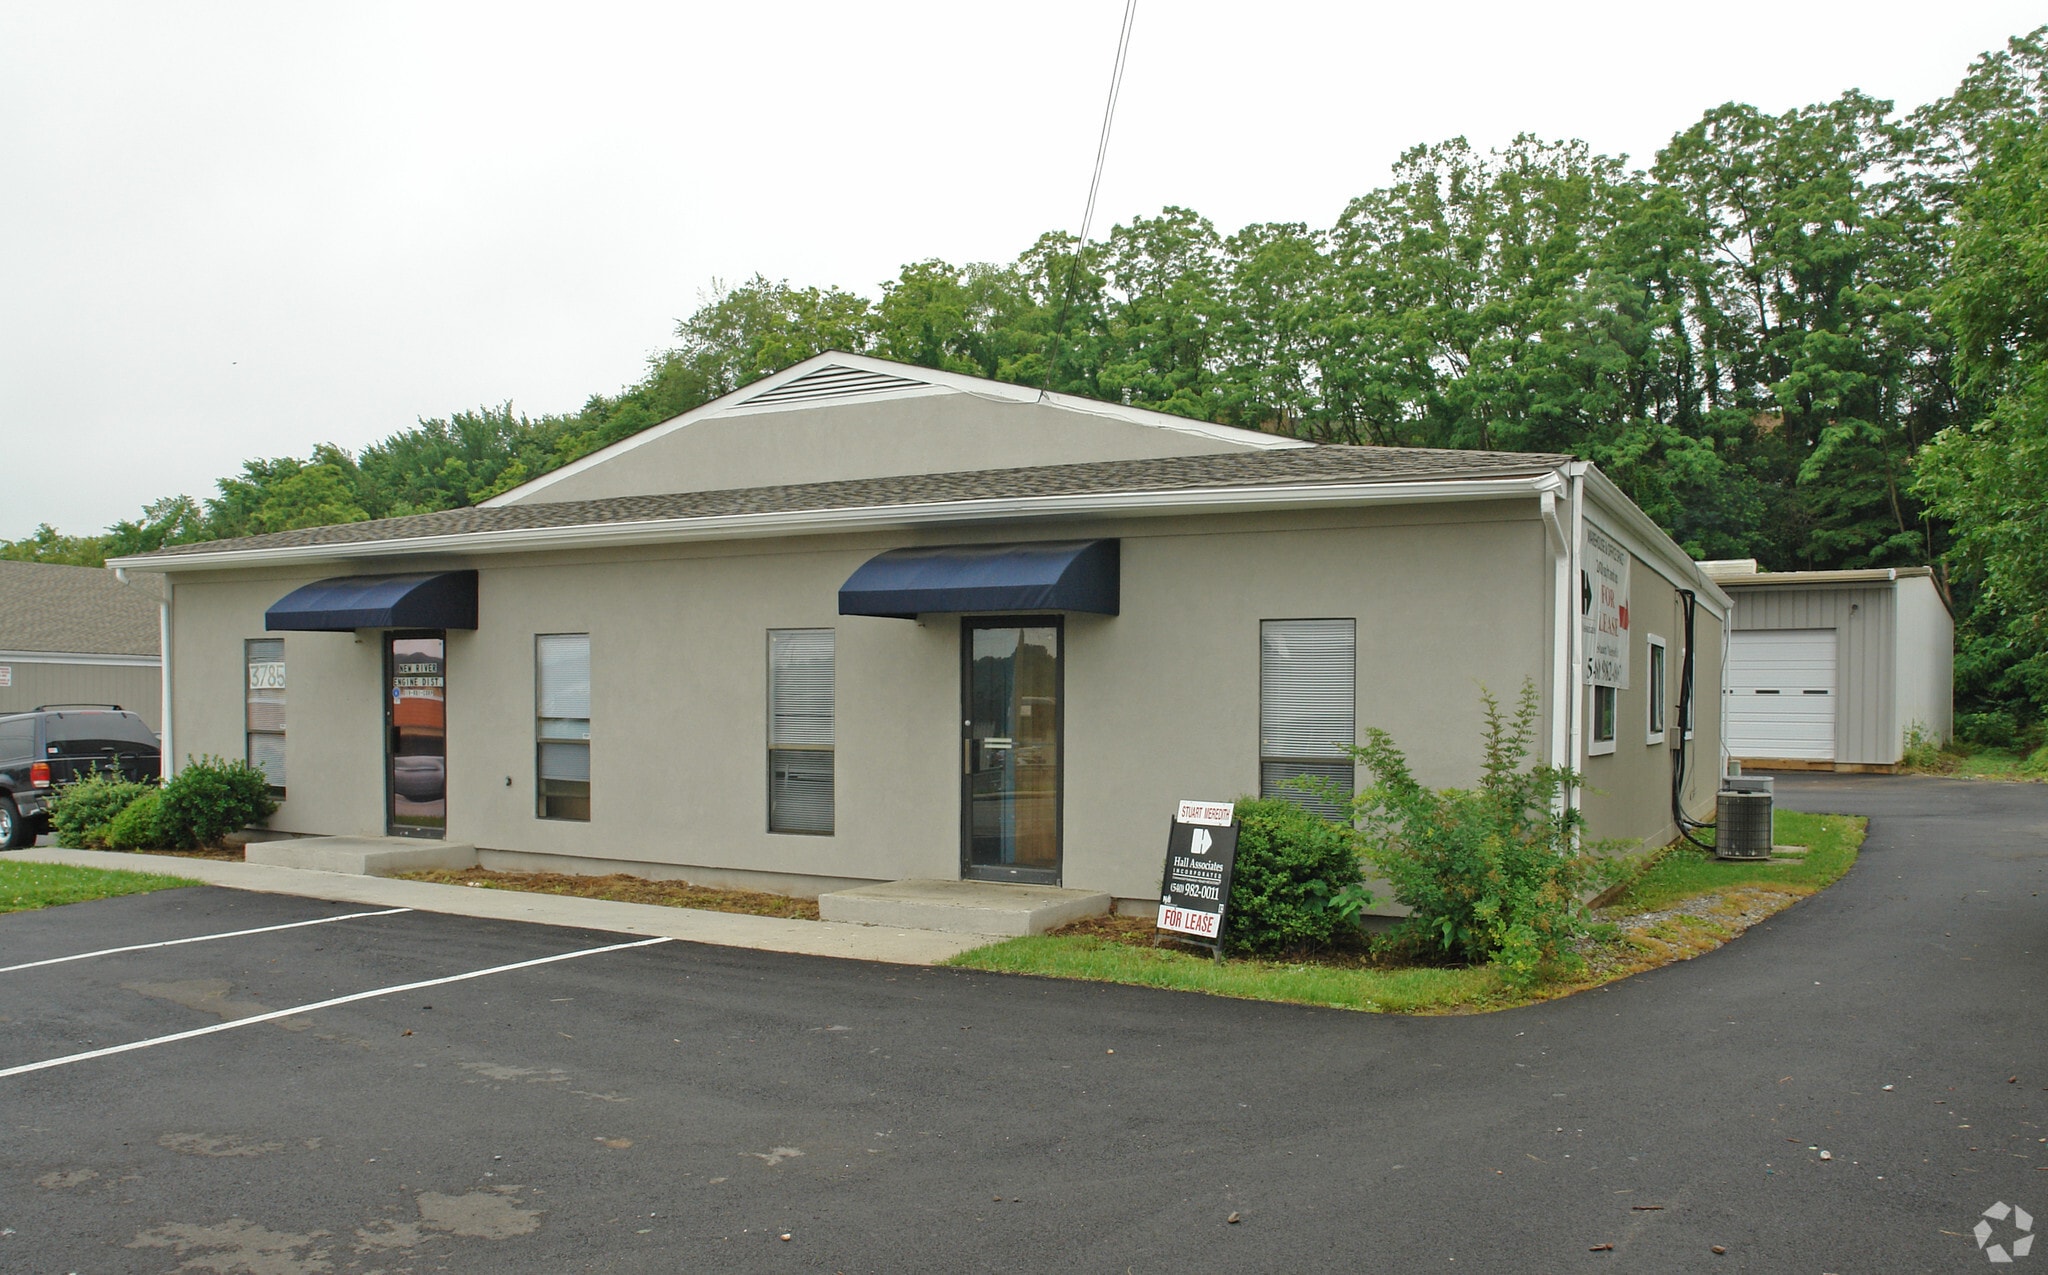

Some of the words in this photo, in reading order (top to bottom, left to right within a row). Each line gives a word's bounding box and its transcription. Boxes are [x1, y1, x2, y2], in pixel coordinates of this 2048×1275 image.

[1602, 585, 1614, 608] FOR
[1599, 613, 1618, 637] LEASE
[251, 665, 285, 687] 3785
[400, 664, 411, 673] NEW
[416, 664, 437, 673] RIVER
[394, 677, 417, 687] ENGINE
[422, 677, 442, 687] DIST.
[1182, 805, 1202, 819] STUART
[1204, 807, 1230, 820] MEREDITH
[1174, 856, 1189, 867] Hall
[1189, 858, 1223, 872] Associates
[1173, 868, 1222, 879] INCORPORATED
[1184, 883, 1219, 900] 982-0011
[1164, 910, 1182, 928] FOR
[1184, 912, 1214, 933] LEASE
